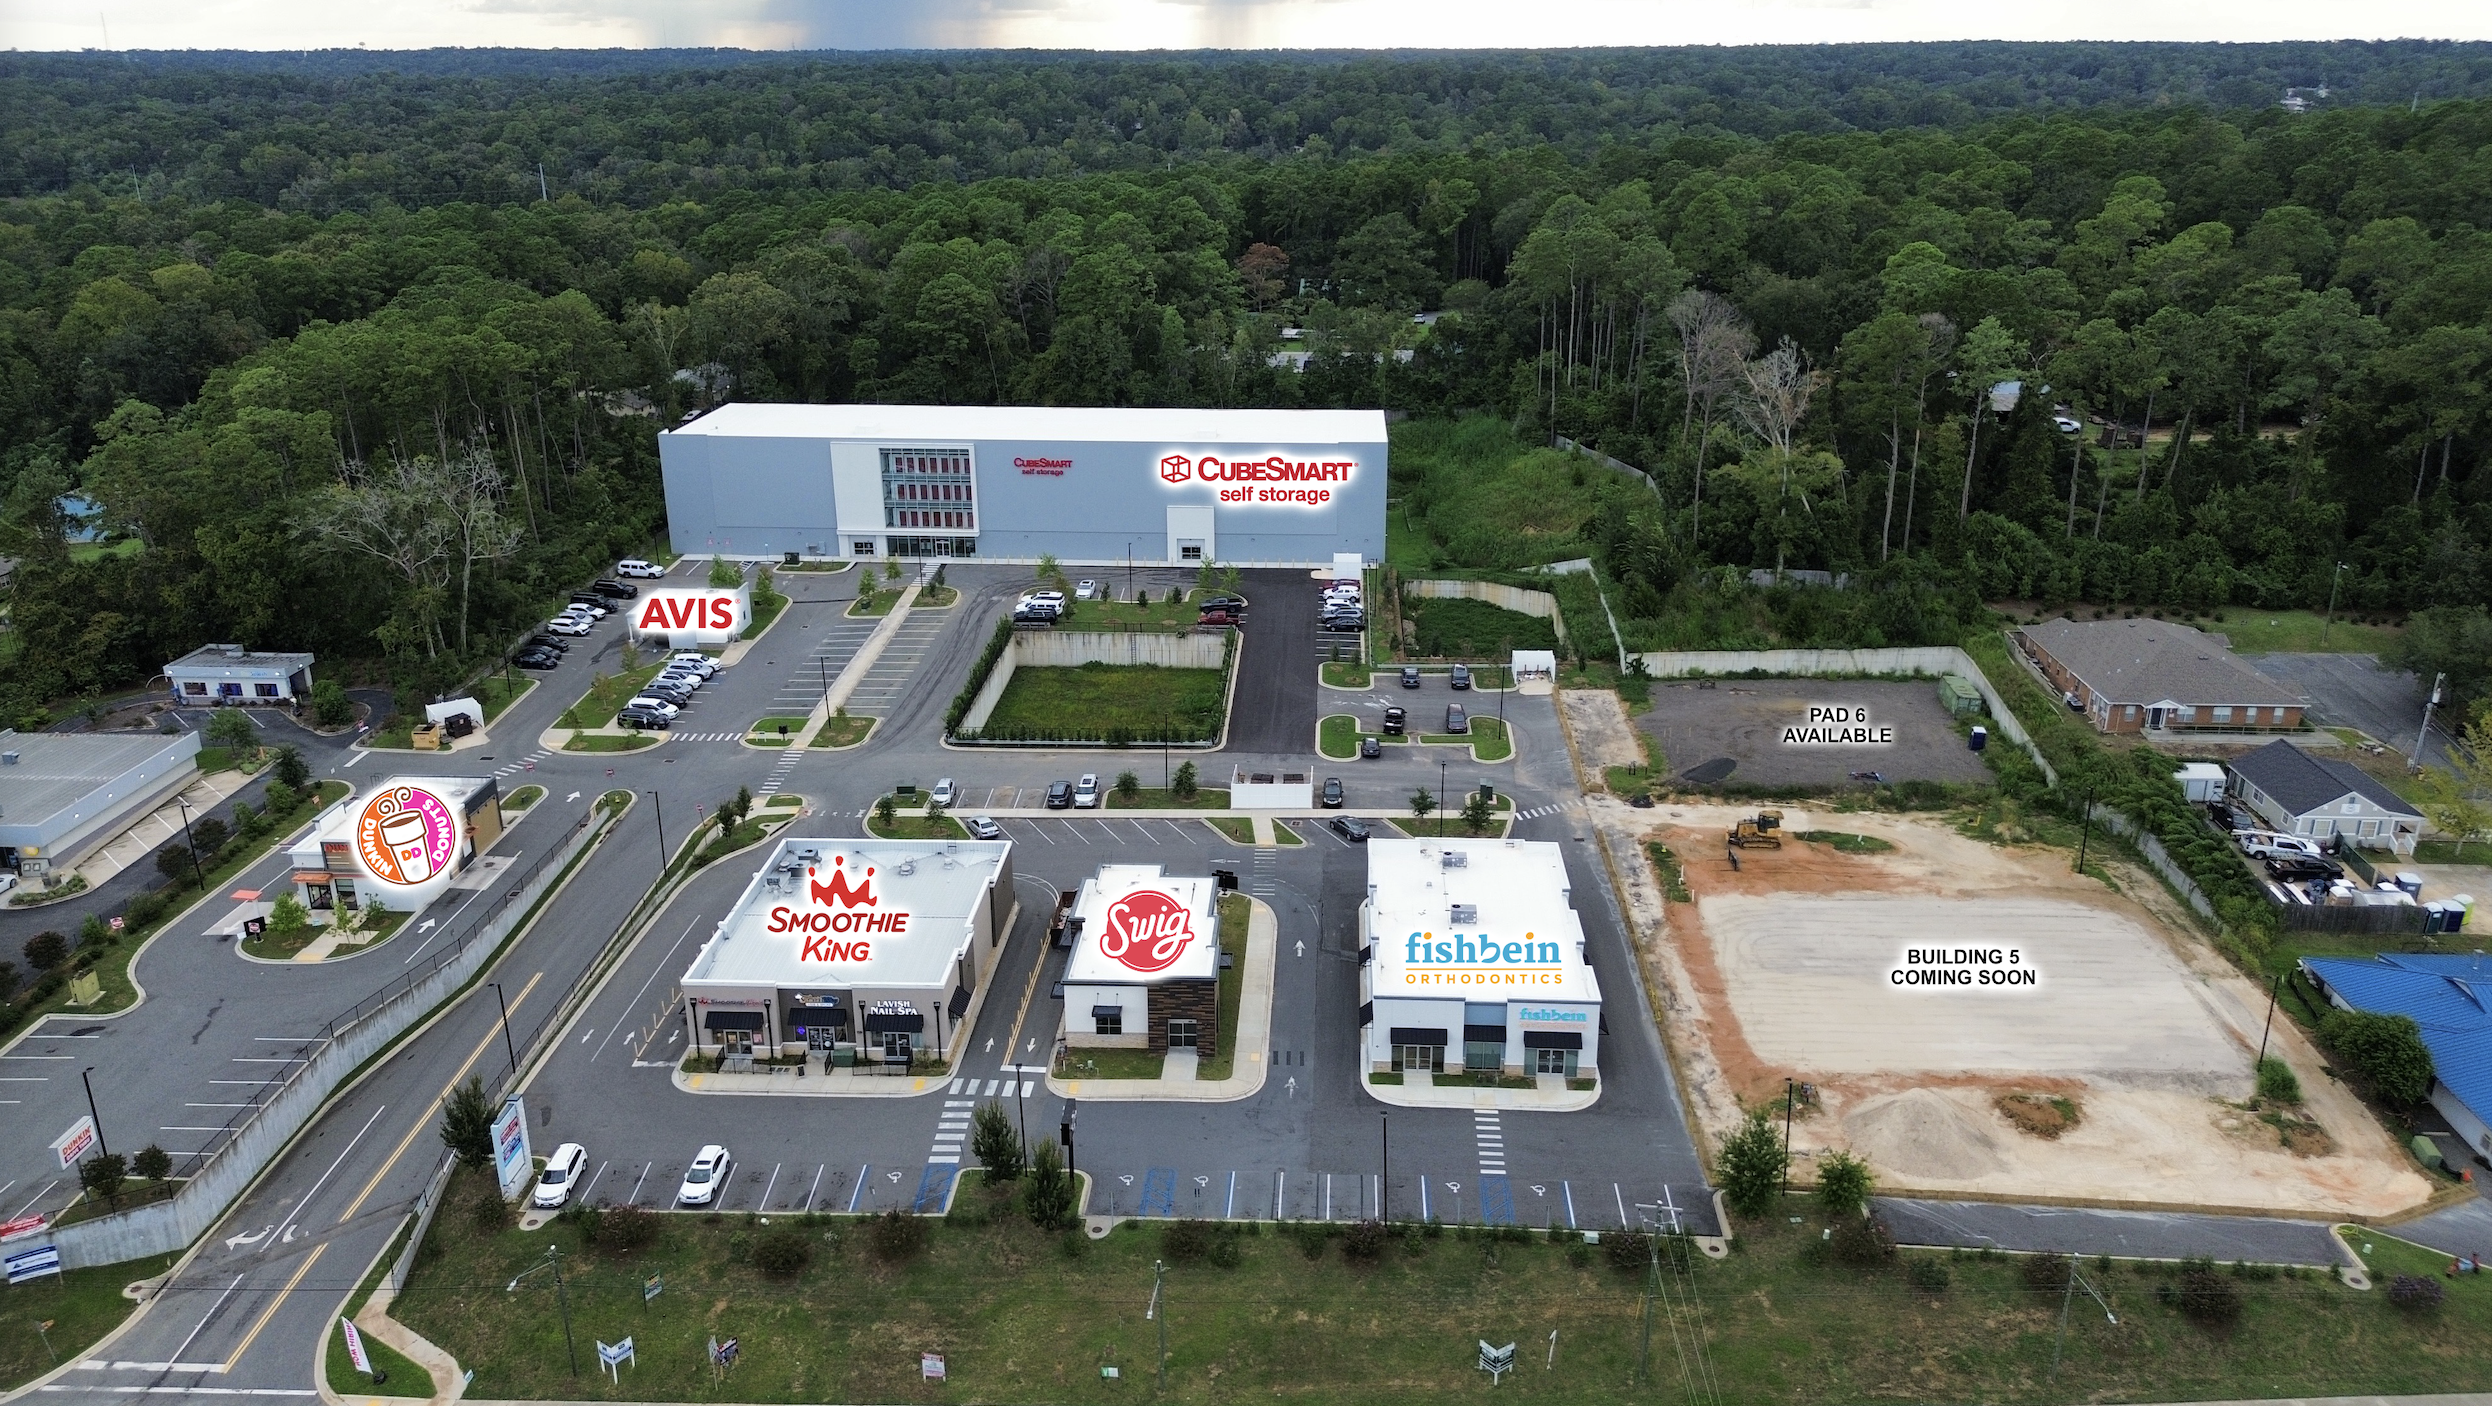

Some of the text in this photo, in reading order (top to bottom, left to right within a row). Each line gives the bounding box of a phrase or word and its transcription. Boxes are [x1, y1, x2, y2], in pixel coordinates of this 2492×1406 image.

[1014, 457, 1073, 468] CUBESMART
[1036, 468, 1064, 477] storage
[876, 1000, 911, 1008] LAVISH
[870, 1006, 918, 1016] NAIL SPA
[1519, 1007, 1587, 1022] fishbein
